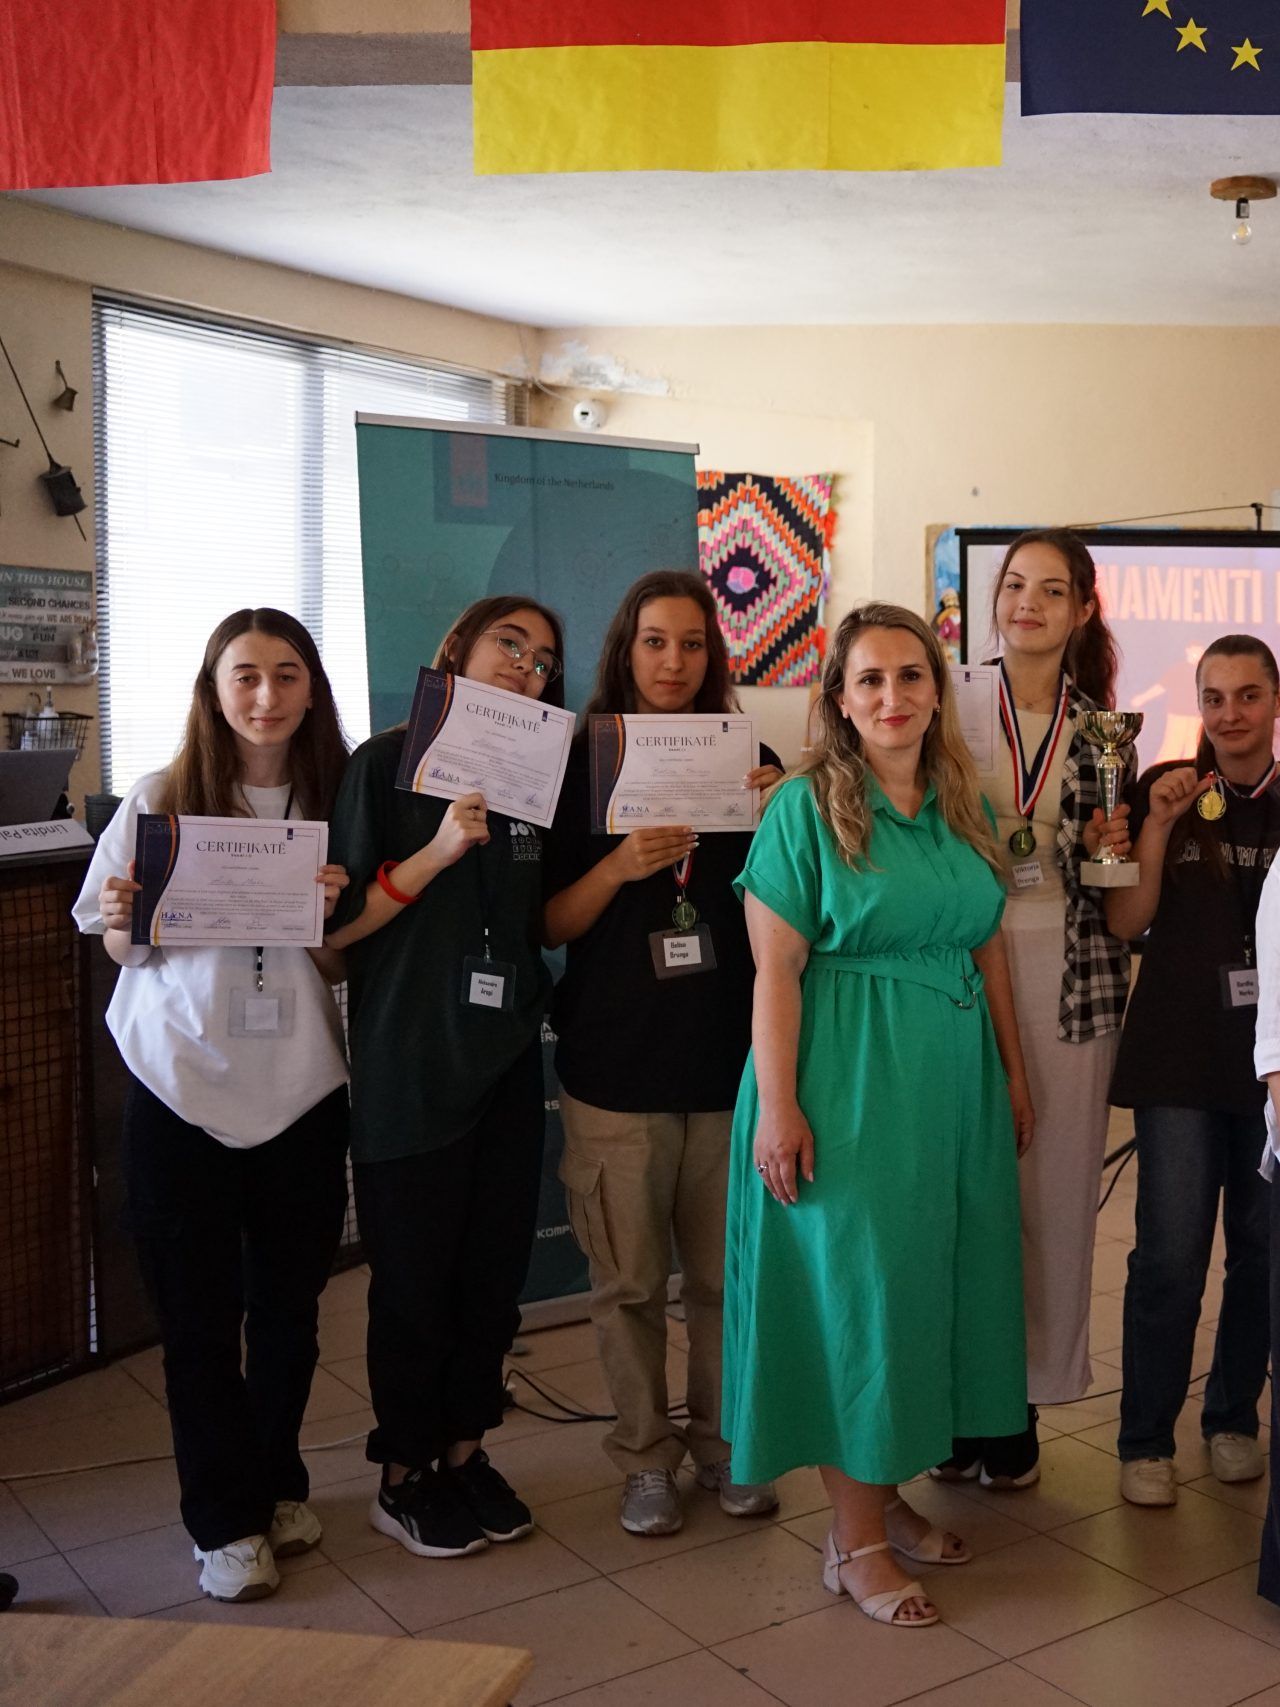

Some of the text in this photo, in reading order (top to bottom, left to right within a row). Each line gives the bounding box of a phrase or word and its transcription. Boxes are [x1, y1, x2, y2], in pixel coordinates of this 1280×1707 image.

[17, 573, 45, 585] THIS
[47, 575, 89, 588] HOUSE
[8, 596, 91, 610] SECOND CHANCES
[33, 633, 55, 641] FUN
[12, 668, 28, 679] WE
[30, 668, 56, 679] LOVE
[466, 702, 541, 734] CERTIFIKATË
[636, 735, 717, 747] CERTIFIKATË
[0, 824, 69, 840] Lindita Pal
[196, 840, 287, 854] CERTIFIKATË
